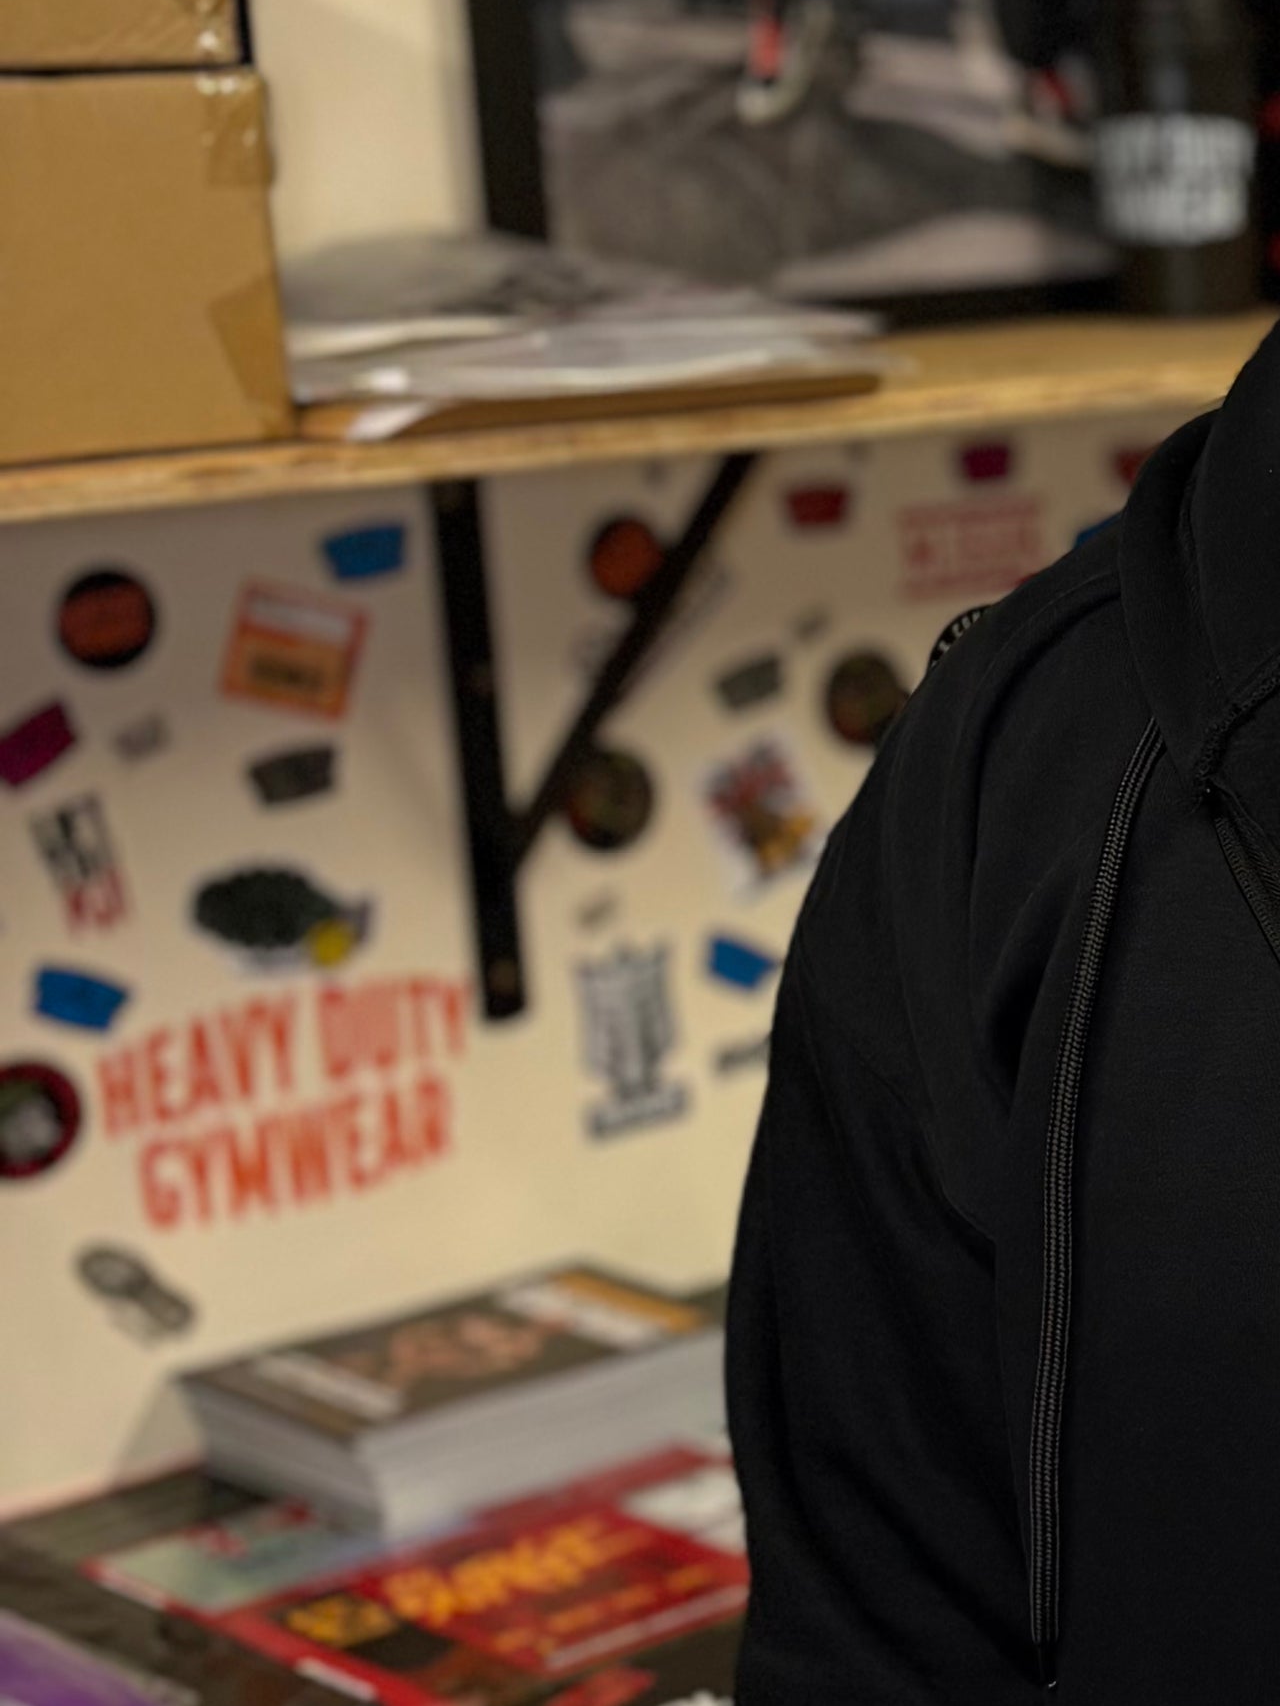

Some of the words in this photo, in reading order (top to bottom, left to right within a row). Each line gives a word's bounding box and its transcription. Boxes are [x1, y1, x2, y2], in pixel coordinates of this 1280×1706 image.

[96, 995, 297, 1143] HEAVY
[317, 975, 470, 1081] DUTY
[139, 1073, 453, 1232] GYMWEAR
